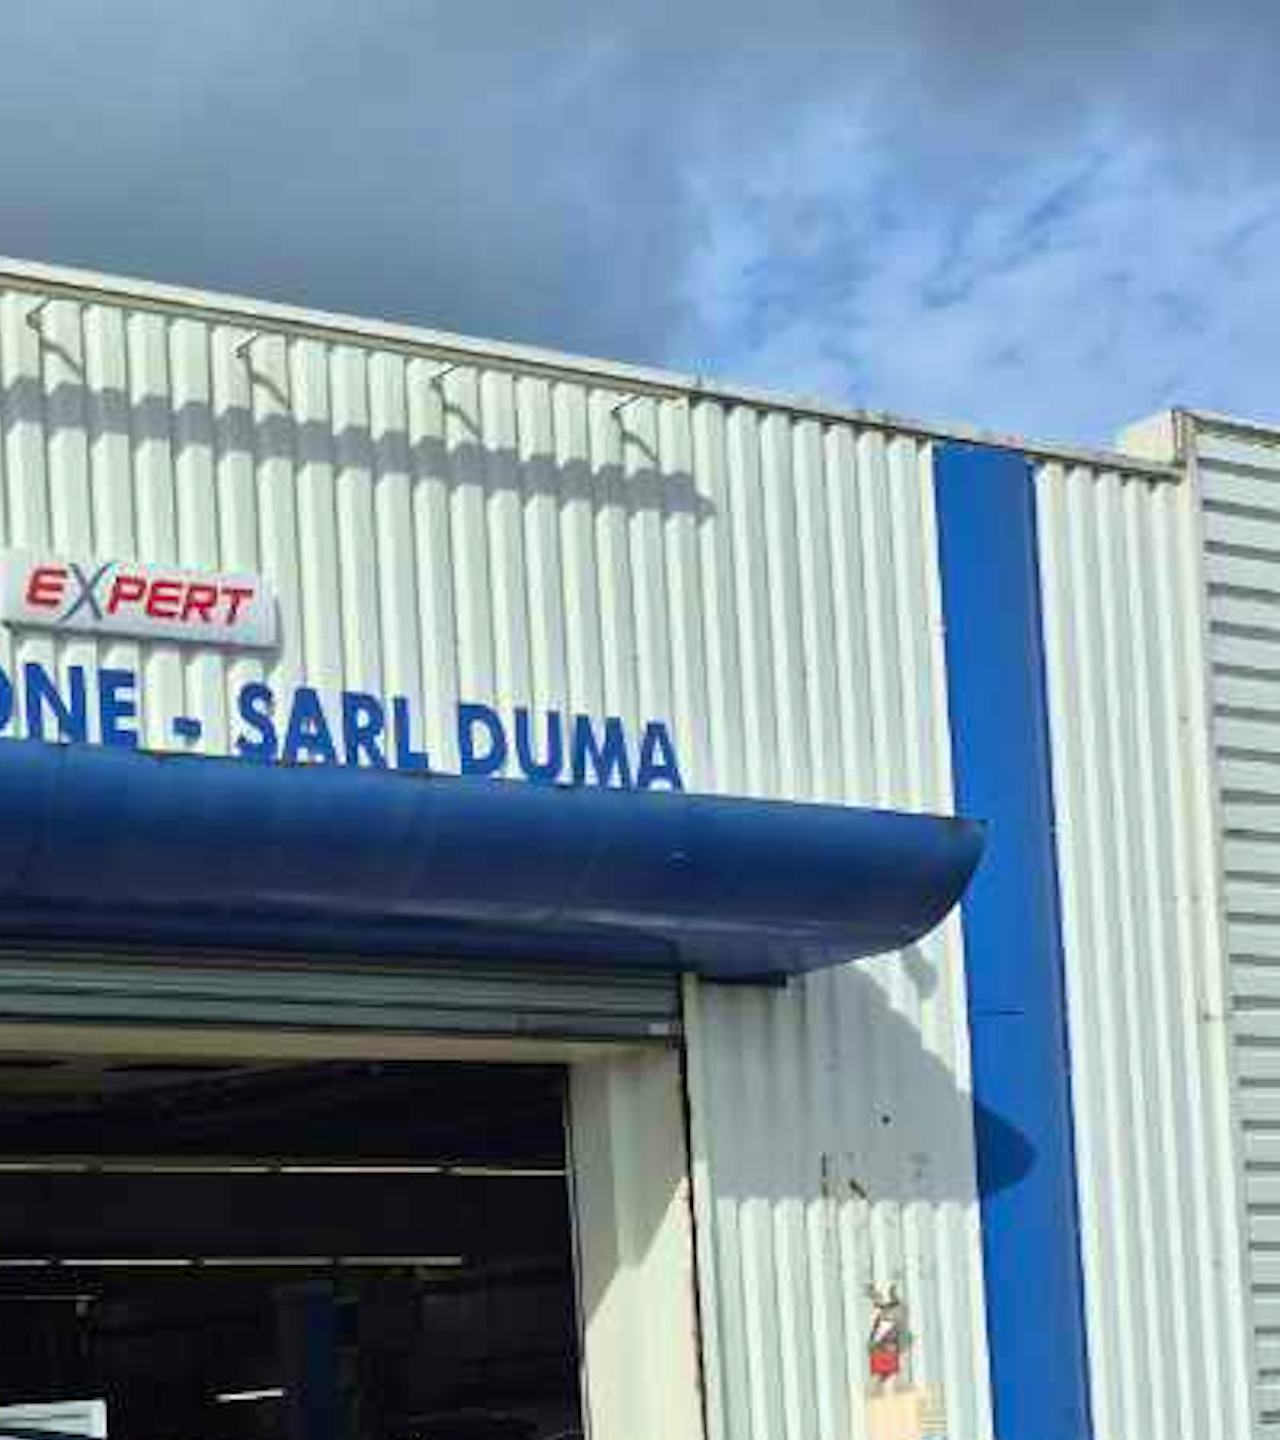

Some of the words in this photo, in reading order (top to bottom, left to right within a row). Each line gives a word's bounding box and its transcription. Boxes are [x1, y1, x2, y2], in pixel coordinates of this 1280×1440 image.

[26, 562, 254, 626] EXPERT
[173, 716, 204, 738] -
[236, 681, 431, 772] SARL
[456, 702, 686, 792] DUMA
